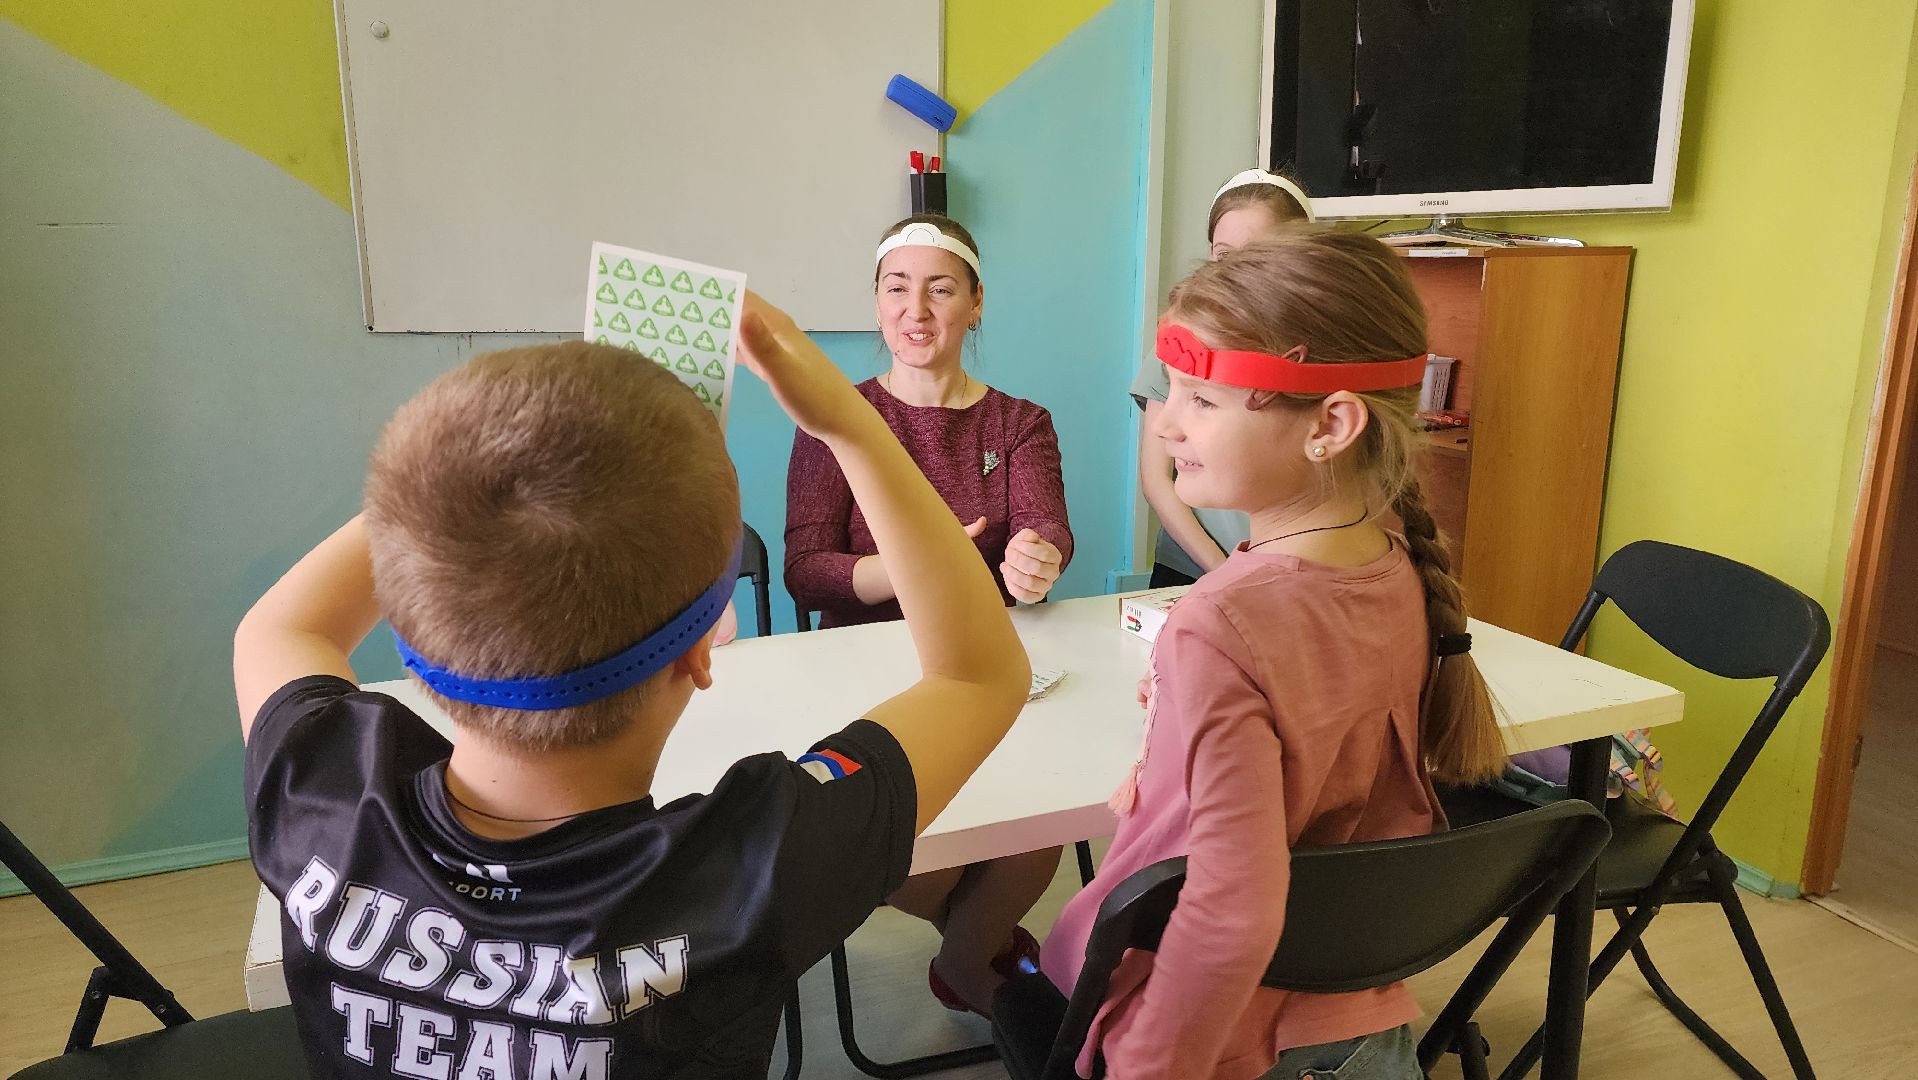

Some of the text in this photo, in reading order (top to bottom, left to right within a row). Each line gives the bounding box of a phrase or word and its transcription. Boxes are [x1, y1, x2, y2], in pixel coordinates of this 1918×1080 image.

[1419, 199, 1449, 207] SAMSUNG
[448, 881, 522, 902] PORT
[285, 855, 690, 1026] RUSSIAN
[330, 981, 614, 1080] TEAM
